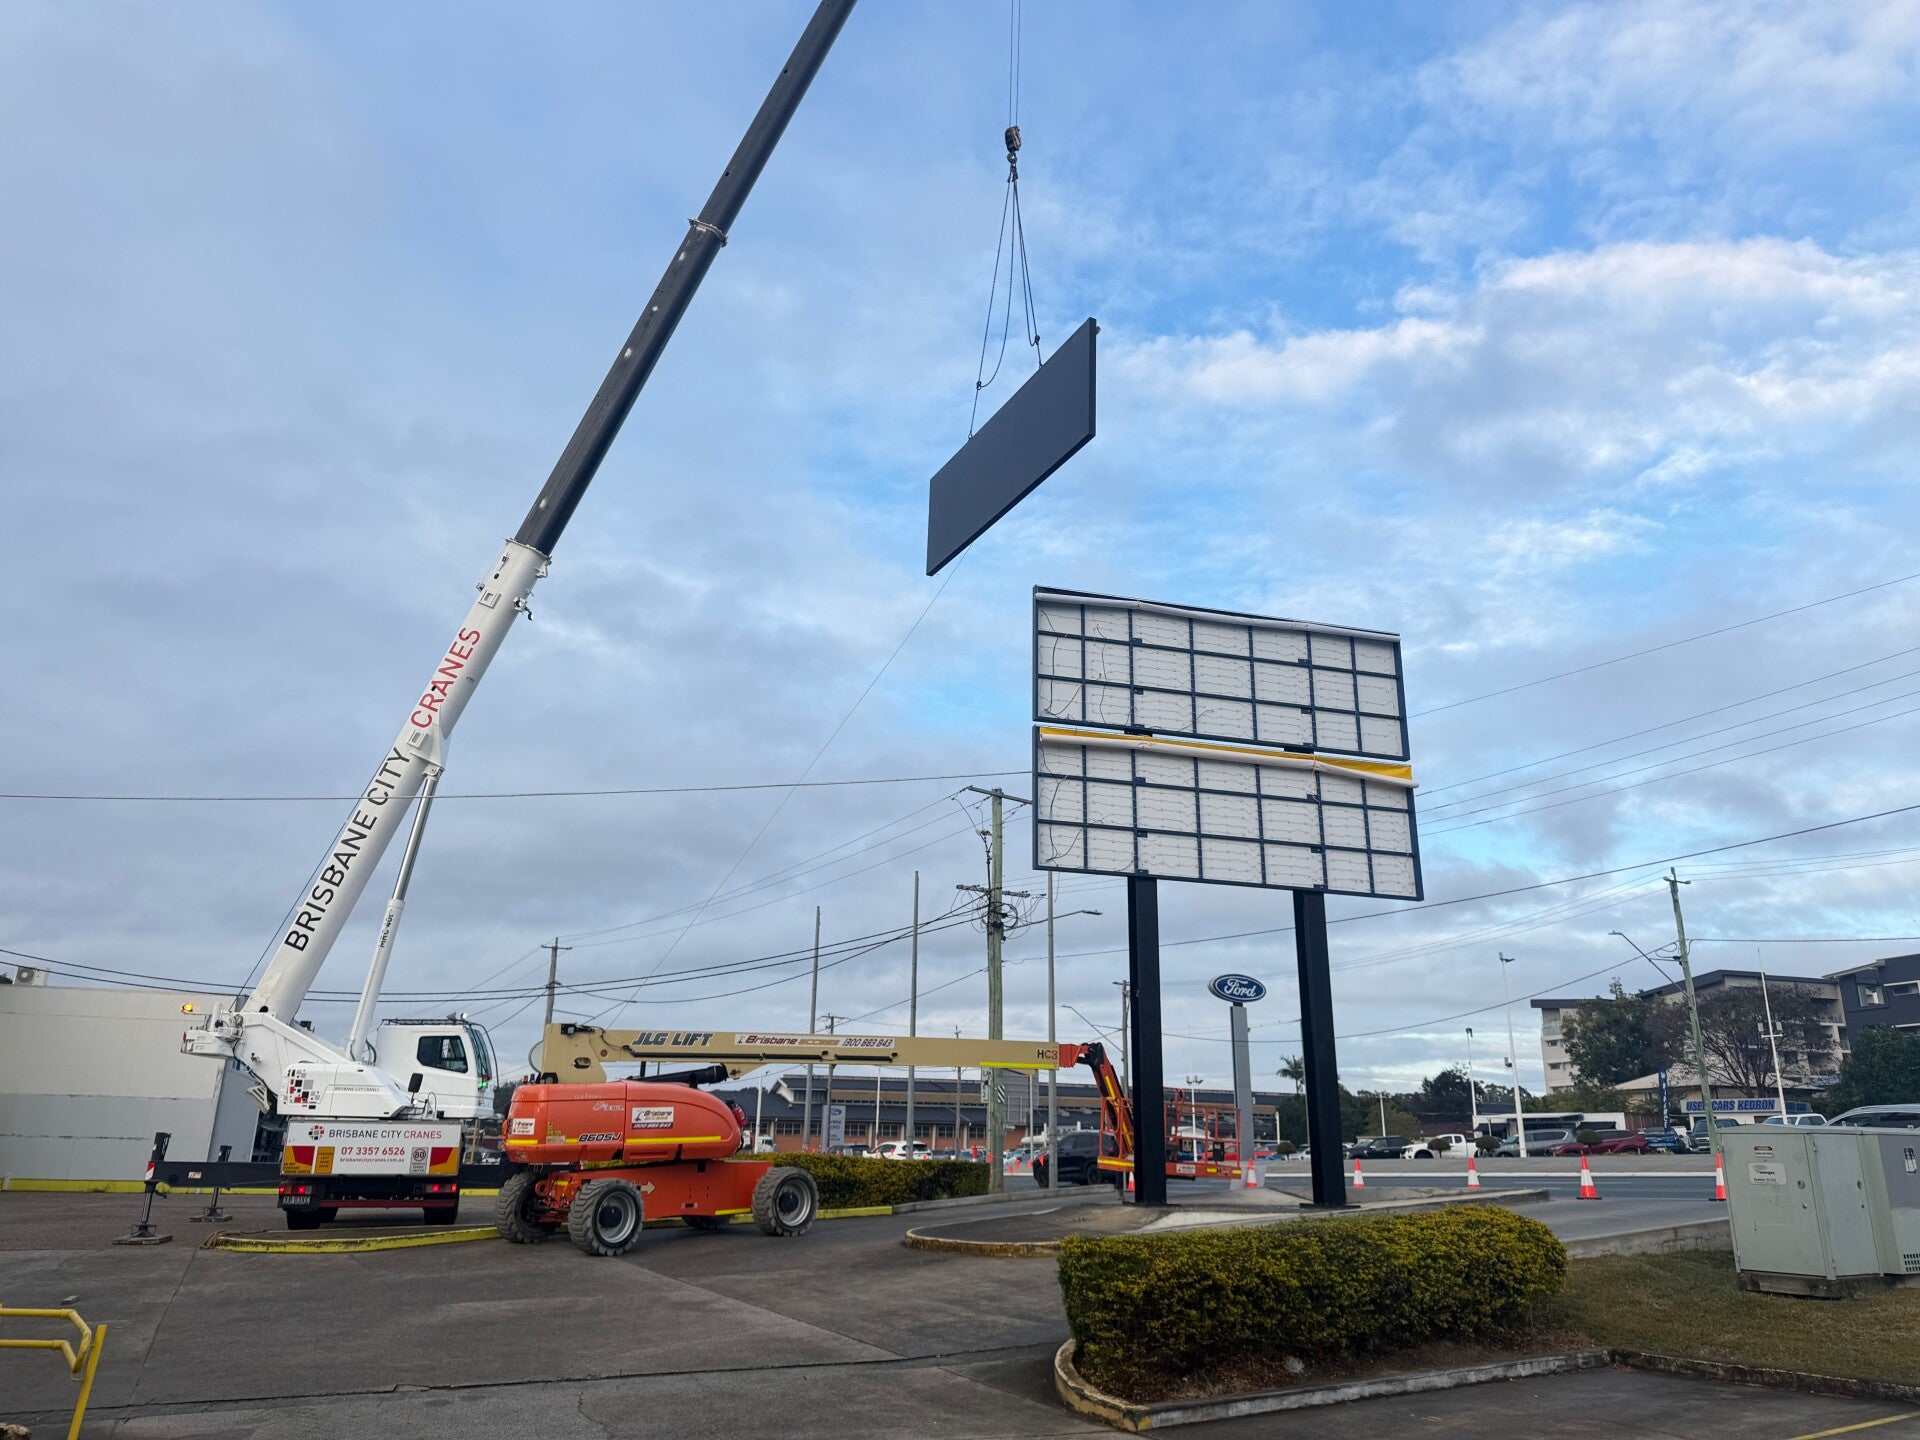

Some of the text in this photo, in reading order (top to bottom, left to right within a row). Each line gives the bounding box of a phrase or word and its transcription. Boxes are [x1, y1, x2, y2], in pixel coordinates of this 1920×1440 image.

[284, 628, 481, 951] BRISBANE CITY CRANES
[1224, 979, 1256, 997] Ford
[632, 1033, 714, 1046] JLG LIFT
[745, 1035, 798, 1045] Brisbane
[1037, 1049, 1058, 1060] HC3
[1711, 1100, 1735, 1111] CARS
[1738, 1099, 1775, 1111] KEDRON
[328, 1129, 442, 1139] BRISBANE CITY CRANES
[341, 1147, 405, 1155] 07 3357 6526
